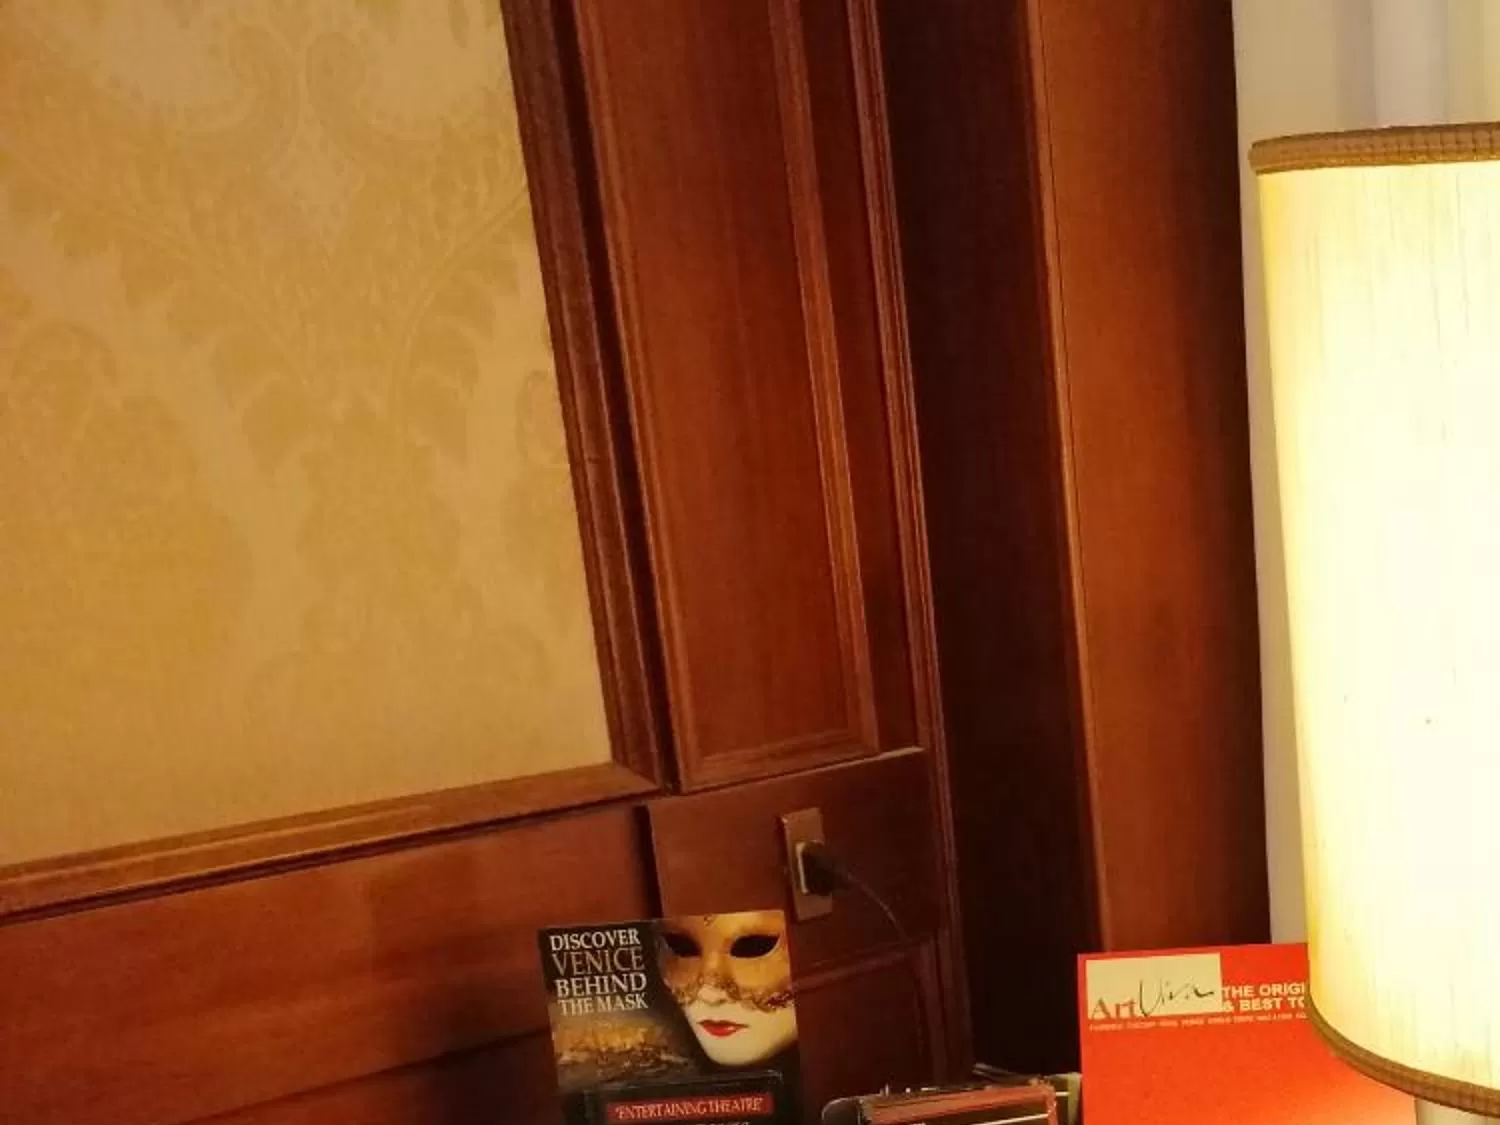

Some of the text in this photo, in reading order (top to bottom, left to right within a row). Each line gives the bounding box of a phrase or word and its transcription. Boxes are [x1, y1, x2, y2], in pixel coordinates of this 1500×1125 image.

[550, 928, 640, 951] DISCOVER
[551, 946, 646, 976] VENICE
[555, 972, 647, 998] BEHIND
[1222, 986, 1254, 998] THE
[557, 993, 649, 1016] THE MASK
[1239, 997, 1282, 1011] BEST
